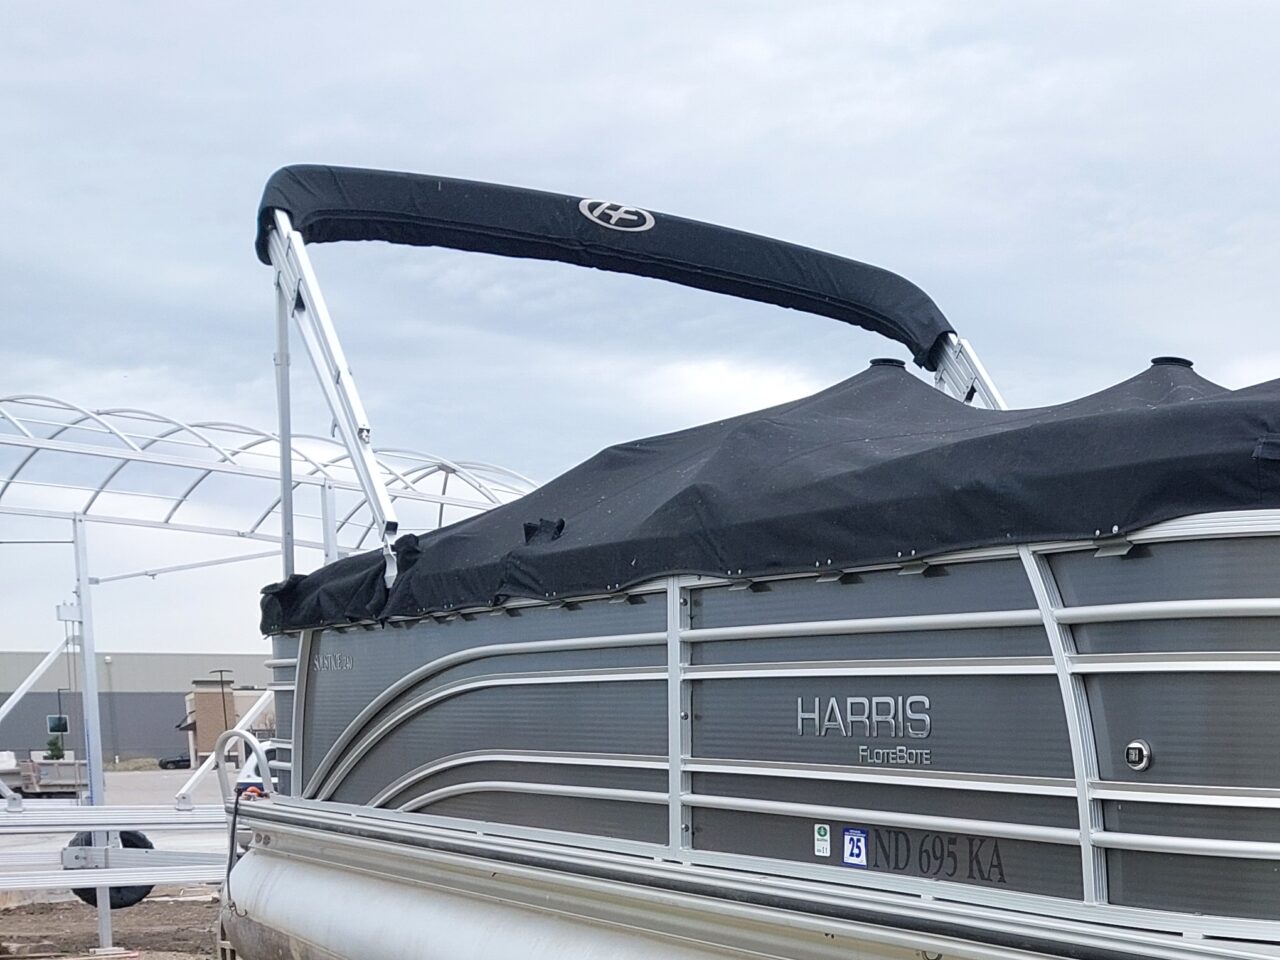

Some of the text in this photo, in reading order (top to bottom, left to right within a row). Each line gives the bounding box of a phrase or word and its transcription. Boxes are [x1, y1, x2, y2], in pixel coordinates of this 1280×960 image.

[797, 695, 932, 738] HARRIS
[849, 836, 862, 859] 25
[872, 828, 1007, 883] ND 695 KA
